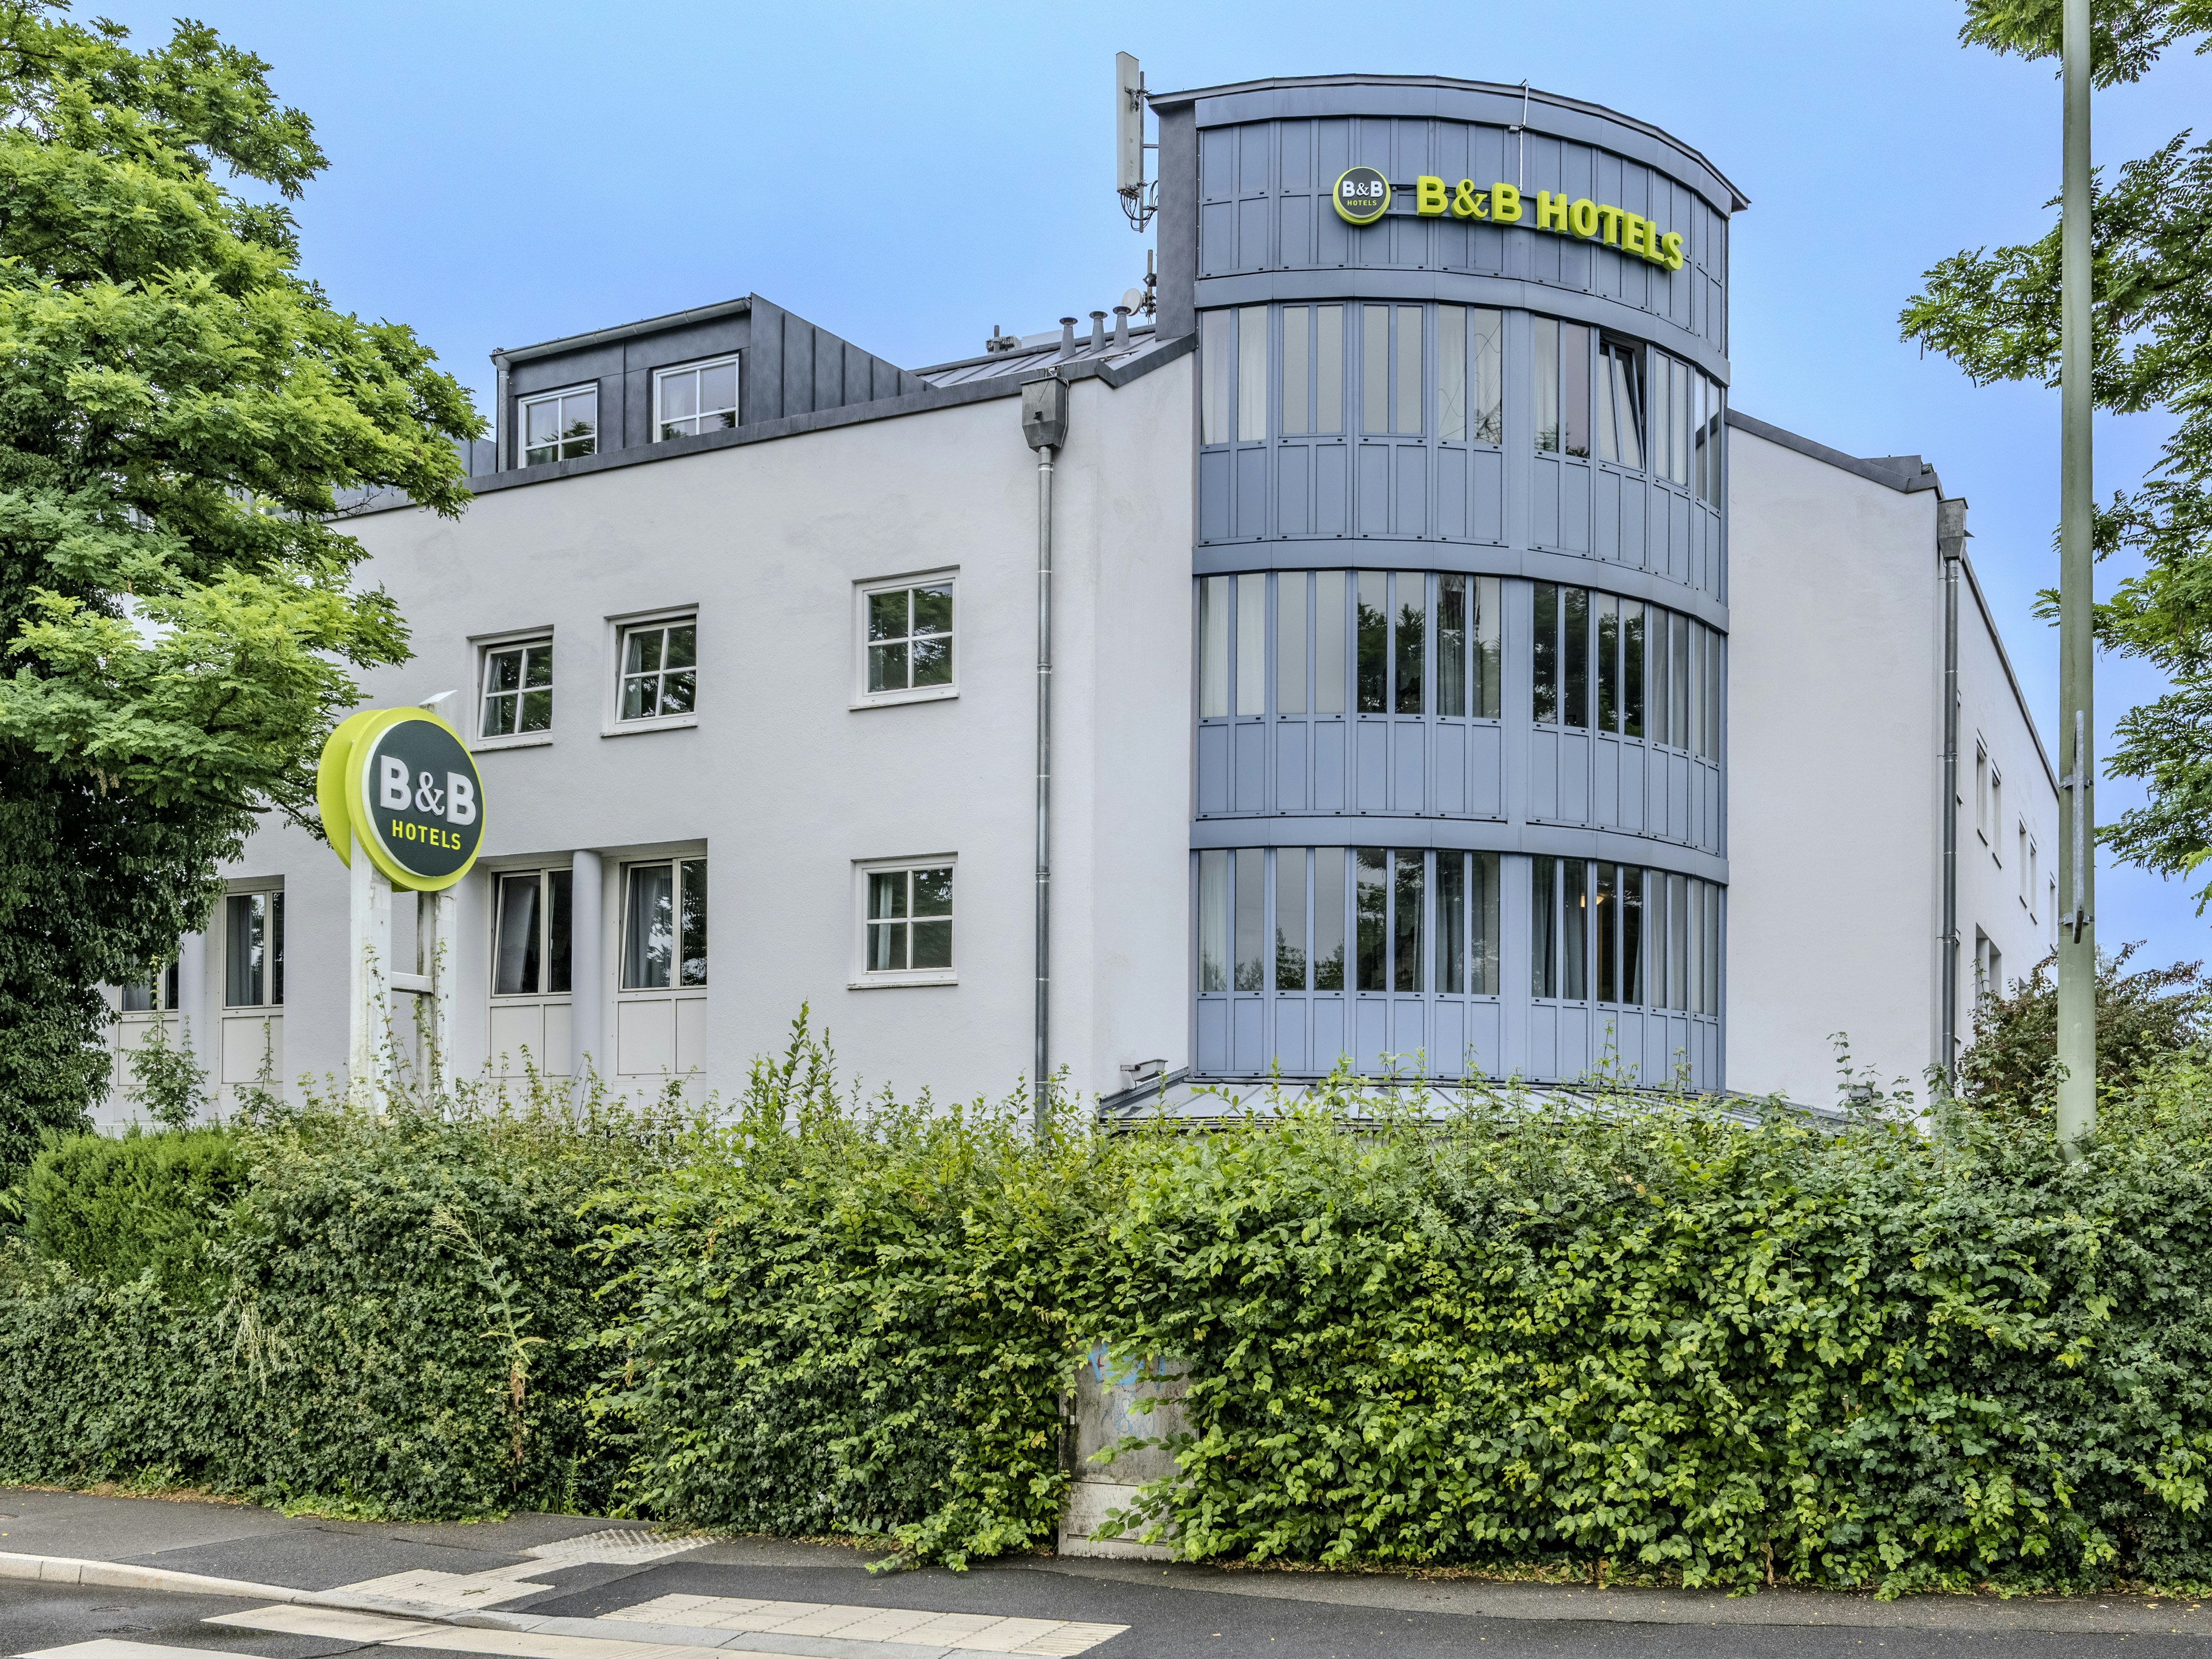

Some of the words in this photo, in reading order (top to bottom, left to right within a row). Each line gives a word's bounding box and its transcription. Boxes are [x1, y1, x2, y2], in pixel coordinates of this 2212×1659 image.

[1342, 180, 1384, 197] B&B
[1416, 175, 1522, 225] B&B
[1536, 190, 1684, 272] HOTELS
[380, 754, 477, 826] B&B
[392, 819, 461, 851] HOTELS
